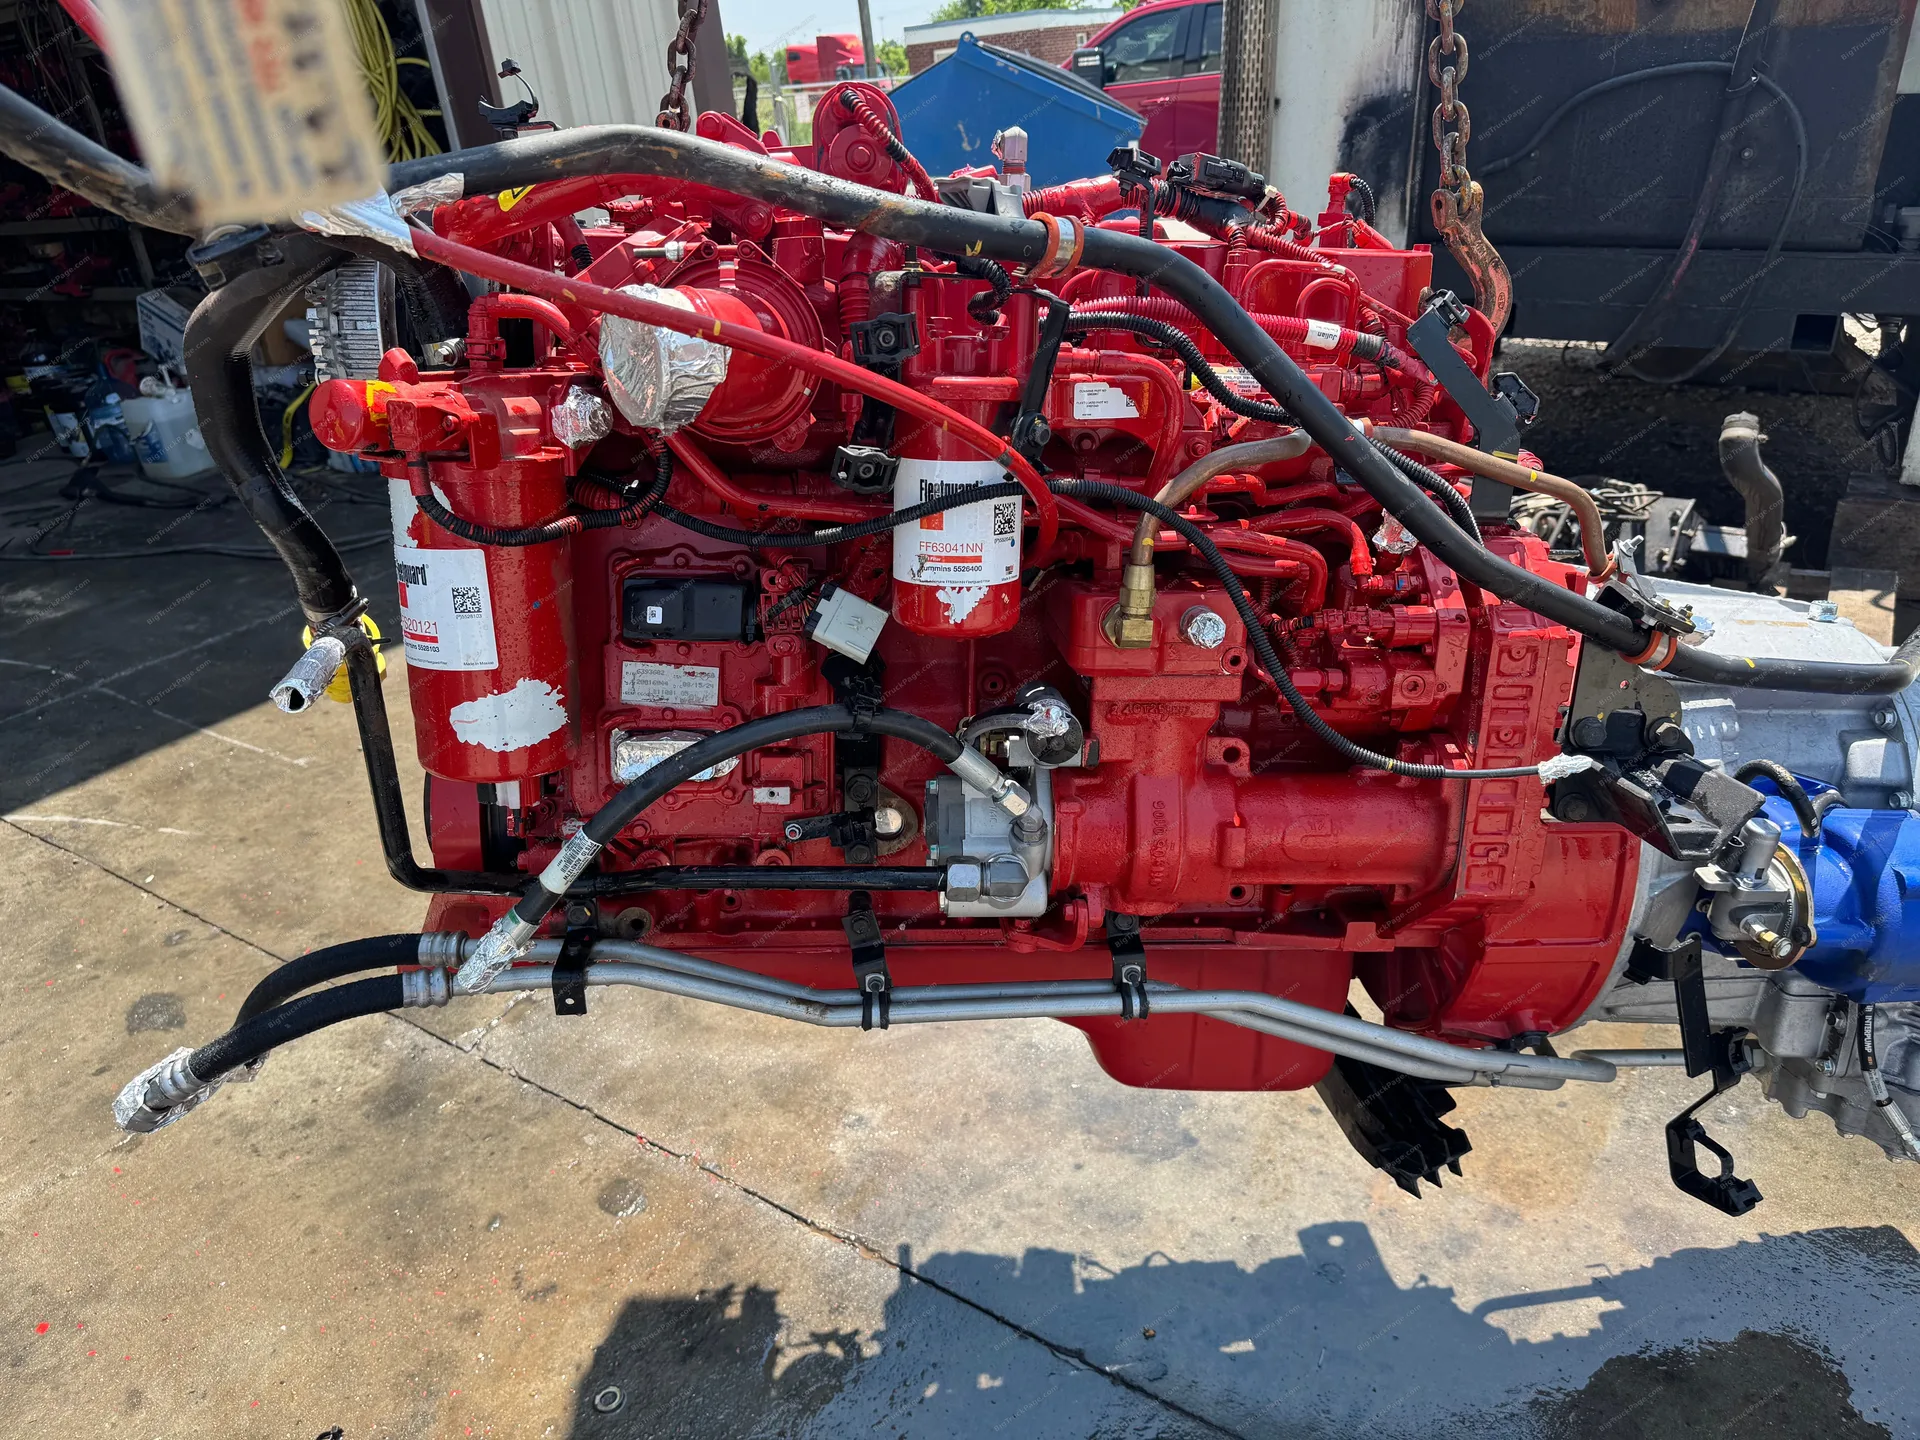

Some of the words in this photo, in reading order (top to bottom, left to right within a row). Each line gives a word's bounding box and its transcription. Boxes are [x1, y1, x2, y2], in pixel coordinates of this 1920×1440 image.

[919, 541, 984, 553] FF63041NN
[953, 565, 983, 573] 5526400
[418, 644, 440, 653] 5528103
[1864, 1015, 1873, 1053] INTERPUMP
